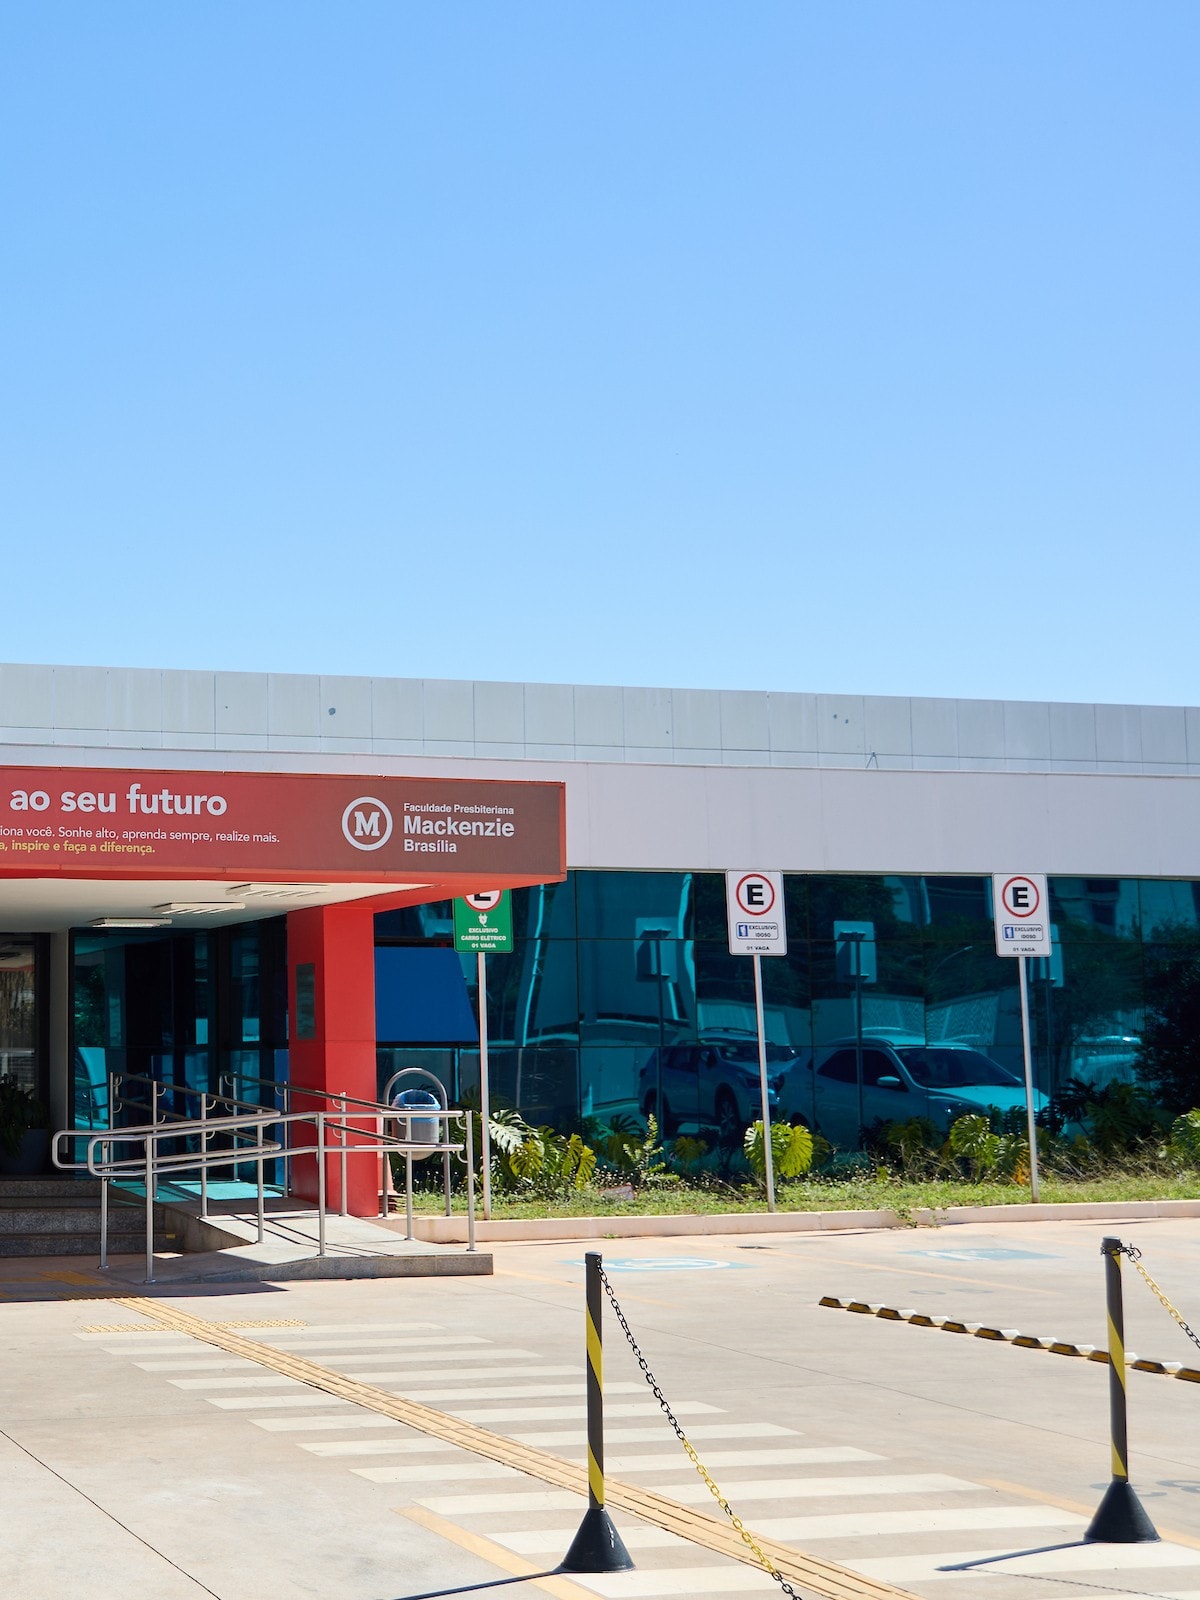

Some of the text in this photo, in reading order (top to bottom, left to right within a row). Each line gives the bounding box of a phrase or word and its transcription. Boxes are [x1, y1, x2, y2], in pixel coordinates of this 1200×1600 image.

[9, 789, 51, 812] ao
[60, 790, 117, 813] seu
[126, 783, 228, 816] futuro
[403, 802, 515, 815] Faculdade Presbiteriana
[354, 811, 381, 837] M
[403, 815, 515, 837] Mackenzie
[26, 826, 55, 838] você.
[58, 827, 93, 838] Sonhe
[95, 828, 119, 840] alto,
[122, 829, 167, 842] aprenda
[169, 831, 213, 843] sempre,
[216, 830, 250, 842] realize
[253, 832, 280, 843] mais.
[11, 840, 50, 853] inspire
[53, 843, 61, 852] e
[63, 840, 87, 854] faça
[90, 843, 97, 852] a
[100, 841, 156, 856] diferença.
[403, 838, 457, 853] Brasília
[746, 884, 764, 905] E
[1012, 887, 1029, 907] E
